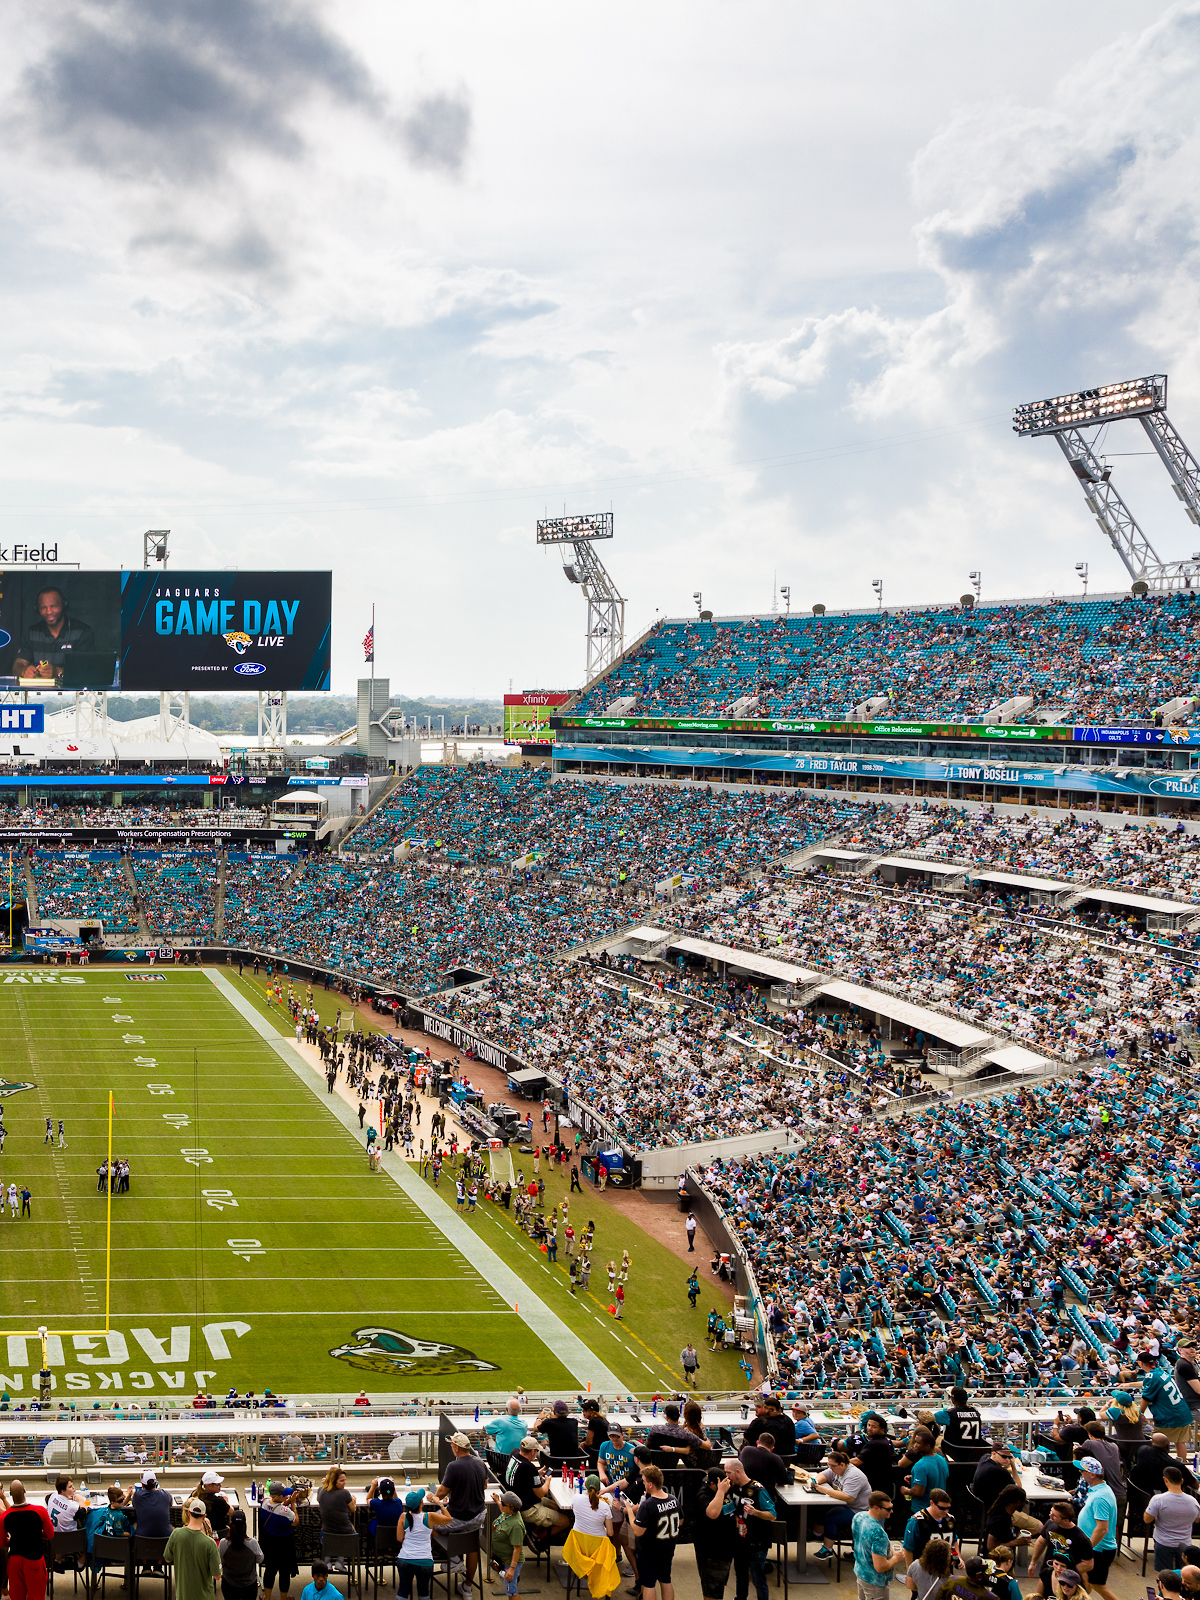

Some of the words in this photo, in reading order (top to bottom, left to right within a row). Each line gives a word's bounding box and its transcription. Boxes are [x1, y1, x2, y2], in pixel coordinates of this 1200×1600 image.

[14, 543, 58, 562] Field
[155, 588, 220, 597] JAGUARS
[155, 600, 236, 635] GAME
[243, 600, 300, 635] DAY
[257, 636, 285, 647] LIVE
[523, 695, 550, 705] xfinity
[891, 726, 923, 734] Relocations
[1145, 731, 1152, 741] 0
[795, 759, 805, 769] 28
[810, 760, 828, 770] FRED
[830, 760, 858, 772] TAYLOR
[943, 767, 953, 778] 71
[957, 767, 980, 779] TONY
[983, 768, 1019, 782] BOSELLI
[1166, 780, 1199, 794] PRIDE
[161, 949, 172, 957] 25
[423, 1014, 452, 1042] WELCOME
[453, 1028, 461, 1046] TO
[146, 1083, 176, 1095] 50
[162, 1113, 192, 1127] 40
[180, 1148, 214, 1164] 30
[201, 1189, 240, 1207] 20
[227, 1238, 267, 1256] 10
[959, 1421, 980, 1440] 27
[657, 1499, 678, 1513] RAMSEY
[50, 1508, 61, 1527] 5
[656, 1512, 680, 1540] 20
